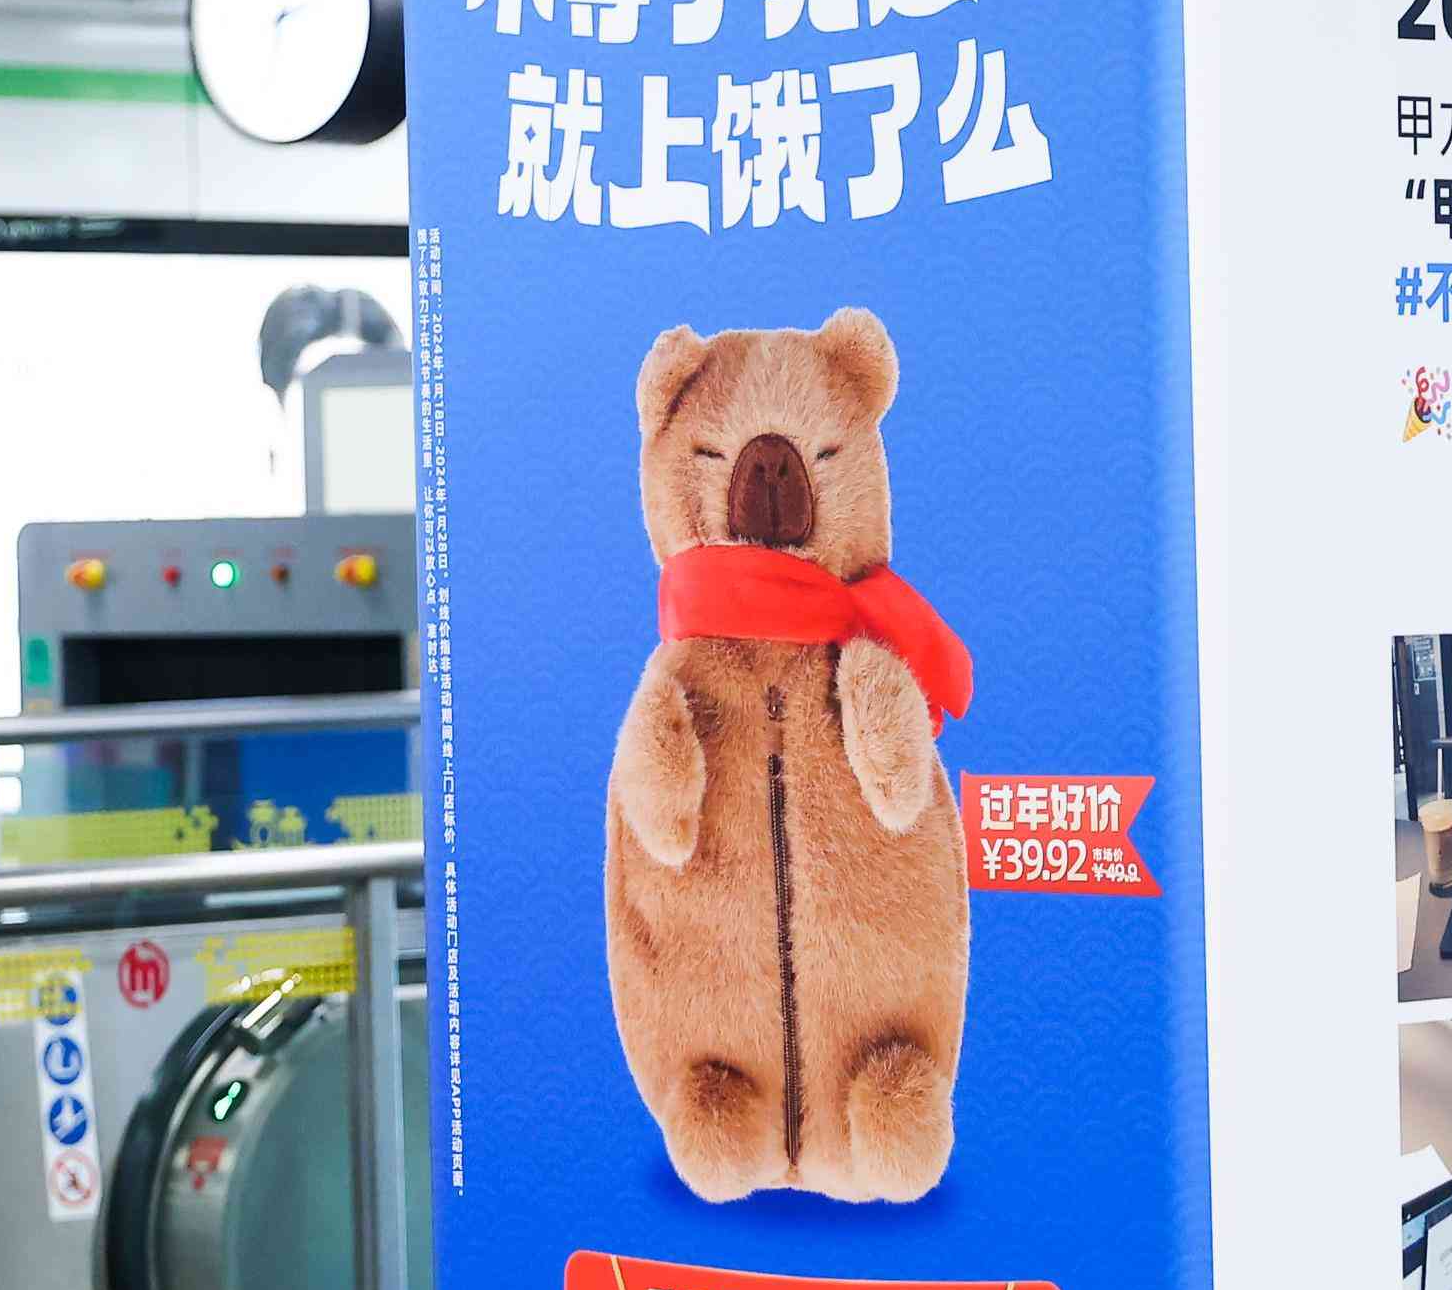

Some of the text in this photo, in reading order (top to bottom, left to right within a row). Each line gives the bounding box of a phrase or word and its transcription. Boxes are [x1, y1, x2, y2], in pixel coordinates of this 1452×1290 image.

[498, 38, 1053, 235] 就上饿了么
[980, 783, 1121, 832] 过年好价
[980, 838, 1088, 881] ¥39.92
[1092, 848, 1123, 861] 市场价
